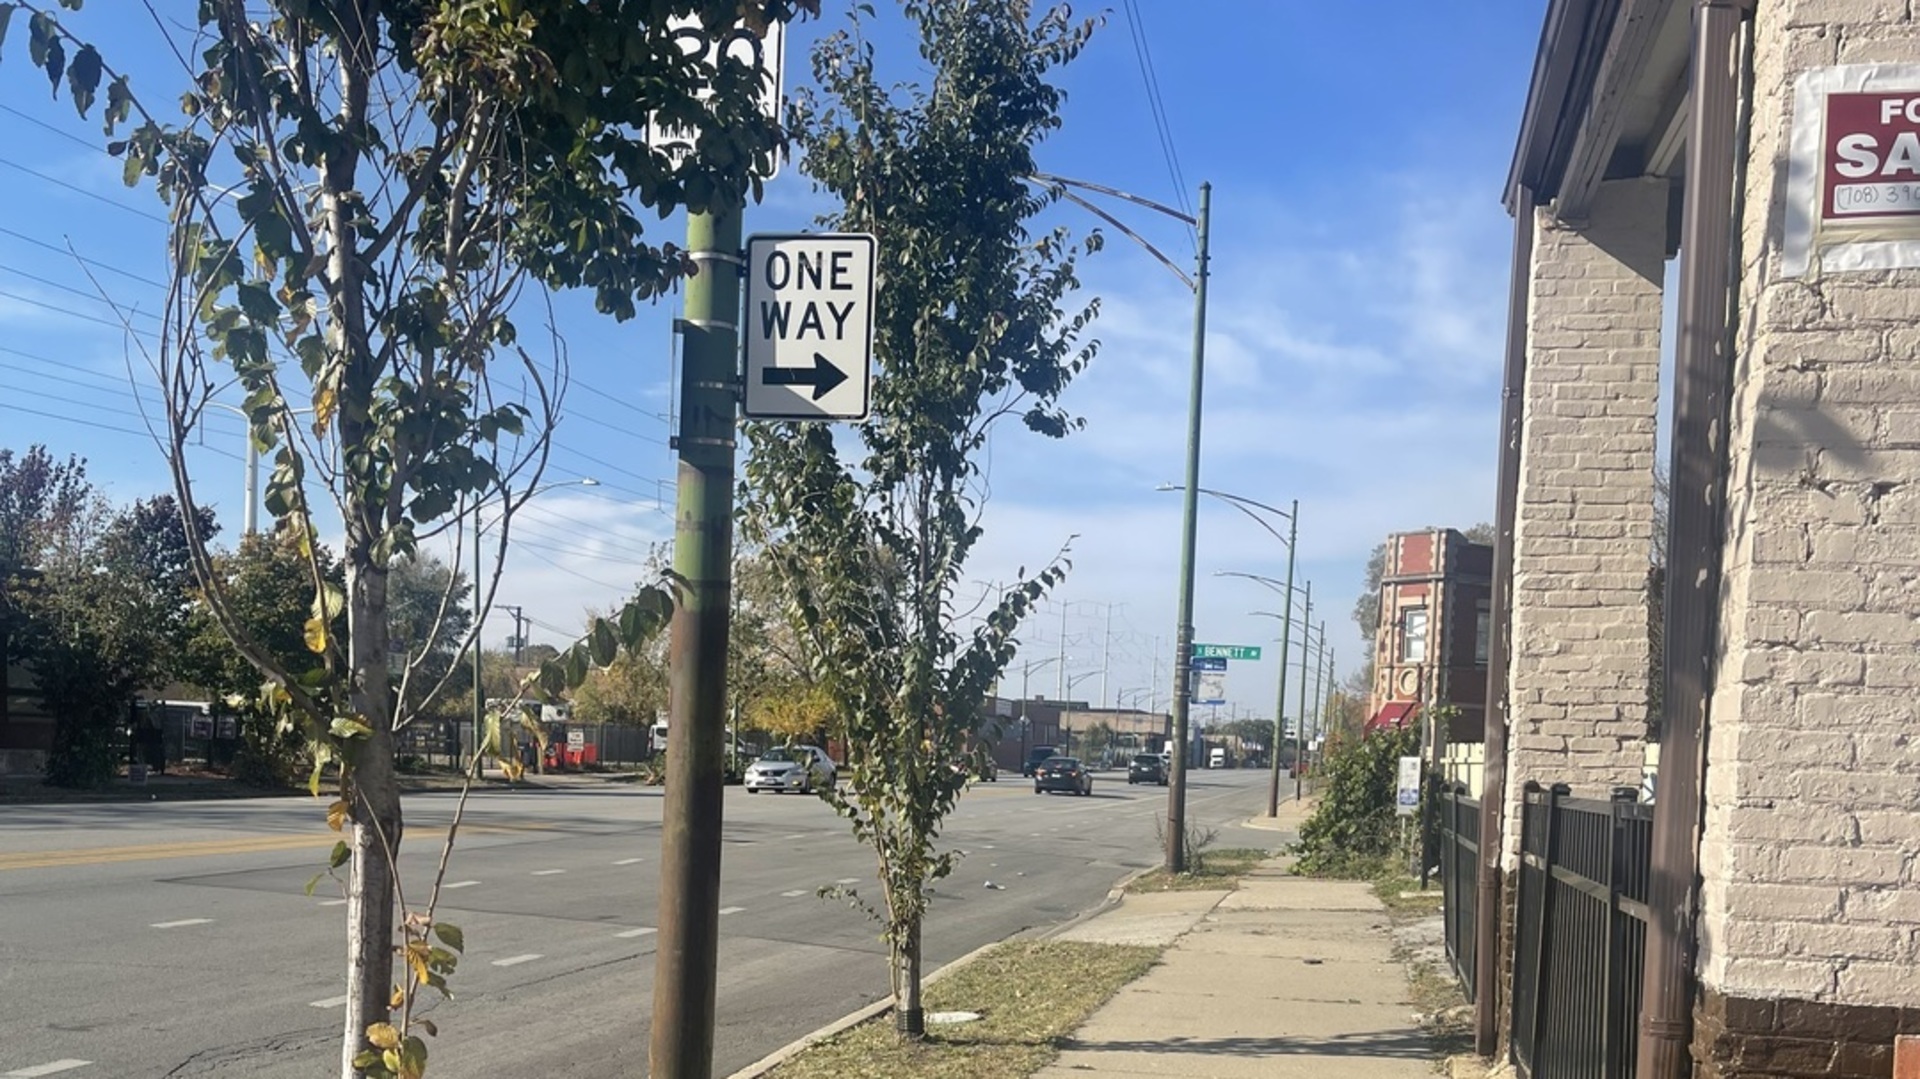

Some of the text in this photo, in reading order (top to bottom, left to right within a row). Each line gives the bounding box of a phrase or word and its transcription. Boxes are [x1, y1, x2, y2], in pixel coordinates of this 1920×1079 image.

[1835, 131, 1920, 178] SA
[1836, 185, 1880, 210] (708)
[765, 250, 853, 291] ONE
[761, 301, 856, 340] WAY
[1205, 646, 1245, 659] BENNETT
